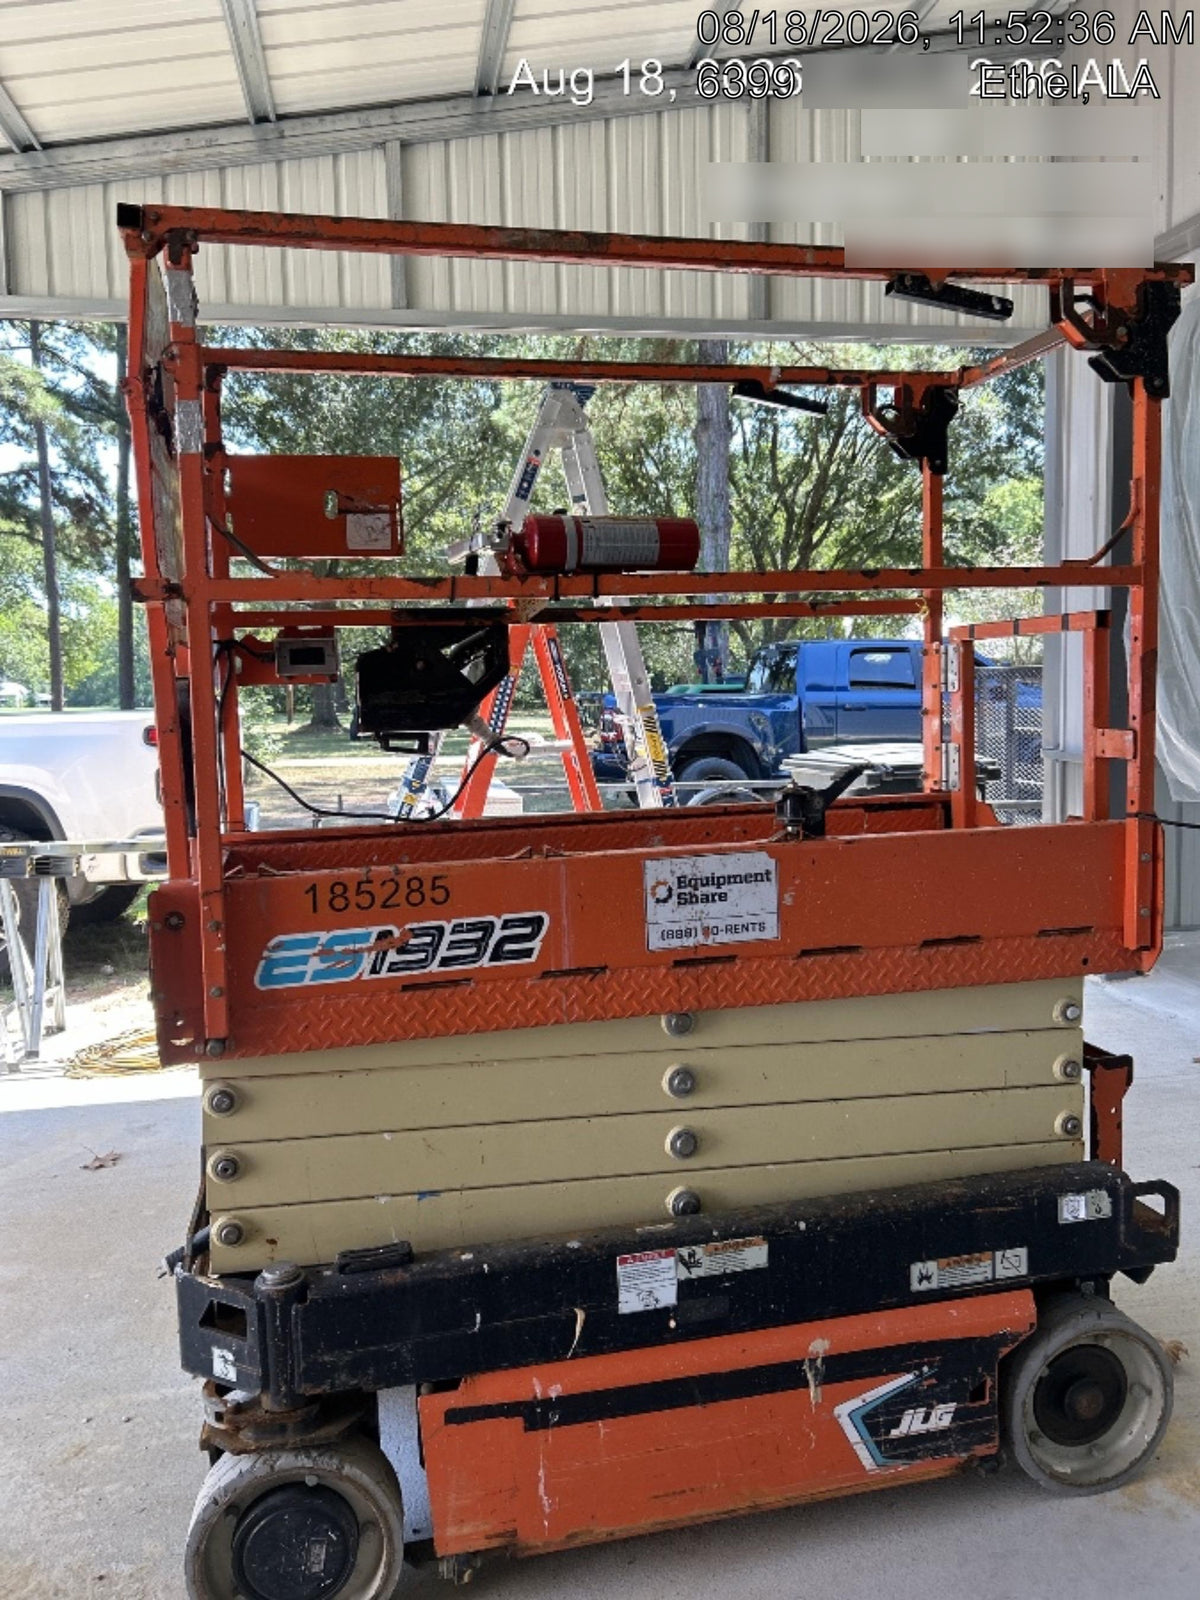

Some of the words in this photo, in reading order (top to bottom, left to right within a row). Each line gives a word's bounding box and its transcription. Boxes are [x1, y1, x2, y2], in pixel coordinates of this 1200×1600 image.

[303, 873, 451, 915] 185285
[676, 868, 773, 891] Equipment
[676, 890, 728, 907] Share
[660, 927, 698, 941] (888)
[252, 910, 550, 991] ES1932
[888, 1402, 958, 1439] JLG
